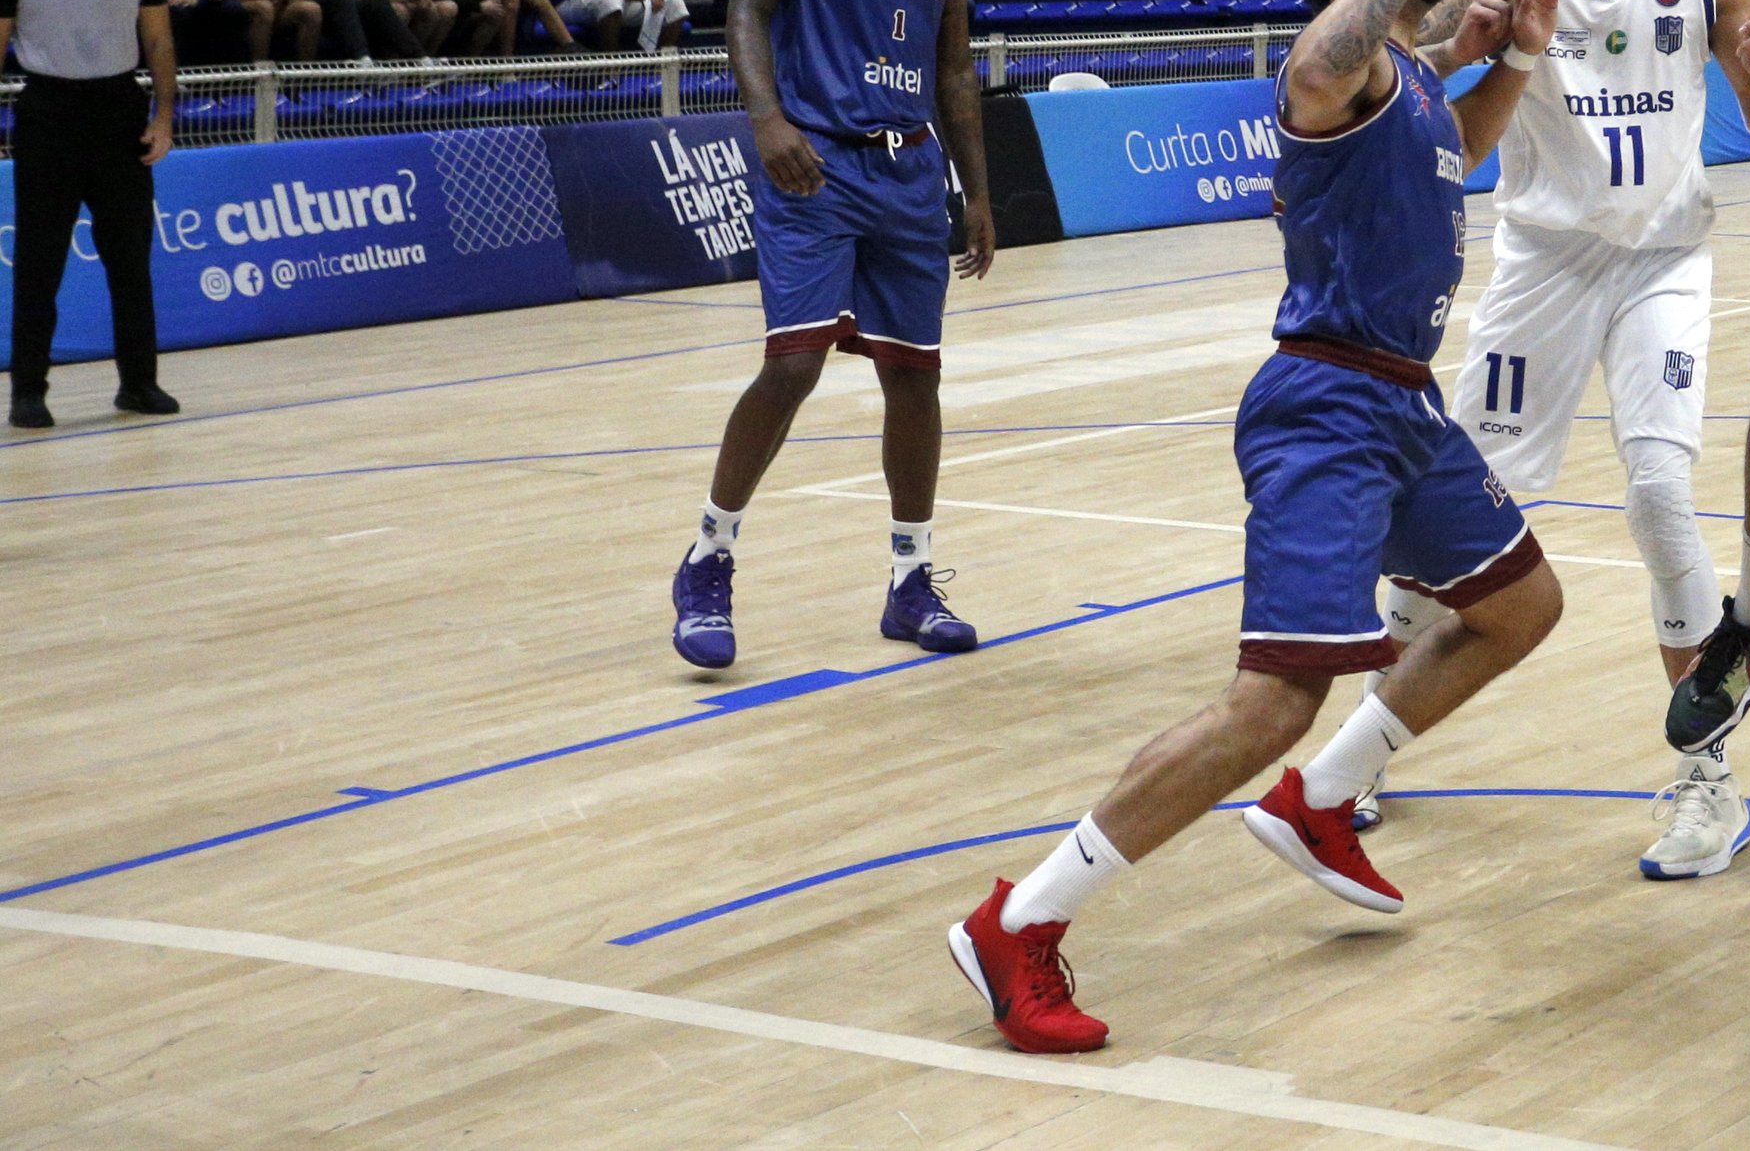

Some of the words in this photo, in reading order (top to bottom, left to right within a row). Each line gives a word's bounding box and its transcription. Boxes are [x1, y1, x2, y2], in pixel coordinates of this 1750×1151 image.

[892, 8, 906, 42] 1
[864, 56, 922, 95] antel
[1563, 87, 1674, 117] minas
[650, 128, 698, 185] LÁ
[691, 137, 749, 184] VEM
[1125, 123, 1214, 175] Curta
[1217, 129, 1238, 163] o
[1603, 125, 1645, 187] 11
[215, 168, 417, 246] cultura?
[664, 178, 755, 226] TEMPES
[694, 216, 756, 261] TADE!
[271, 244, 427, 290] @mtccultura
[1485, 351, 1527, 414] 11
